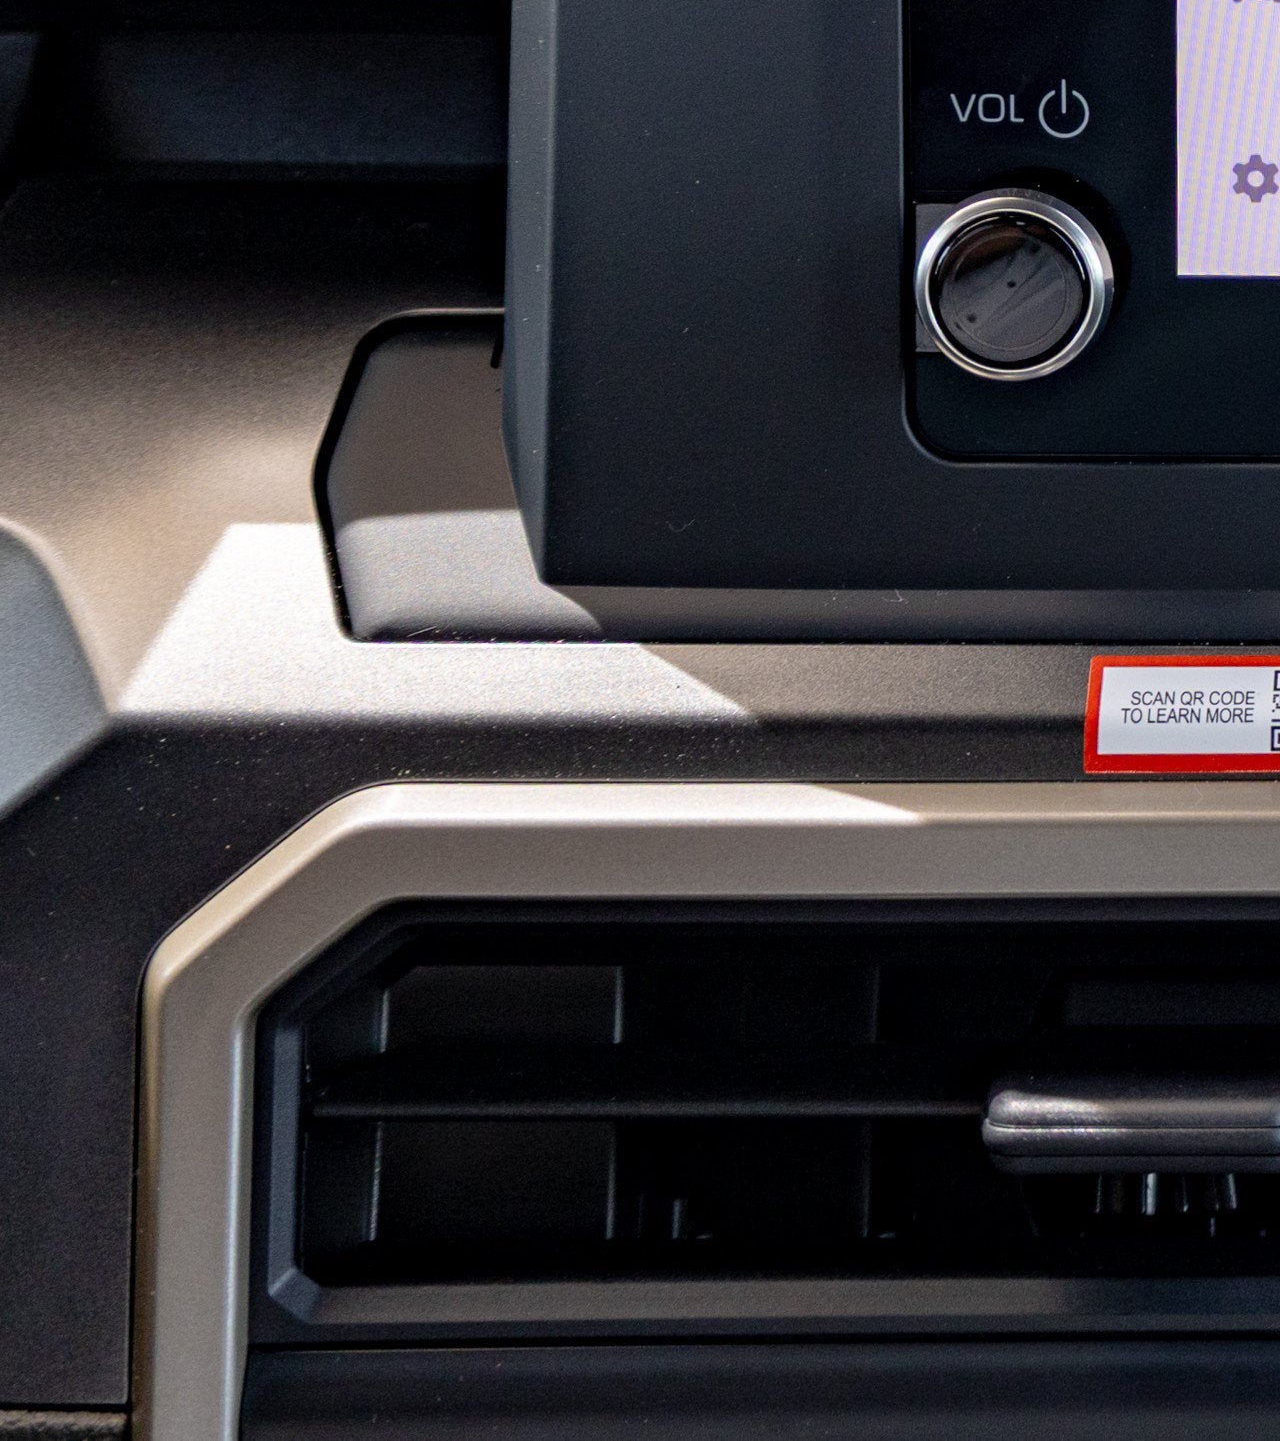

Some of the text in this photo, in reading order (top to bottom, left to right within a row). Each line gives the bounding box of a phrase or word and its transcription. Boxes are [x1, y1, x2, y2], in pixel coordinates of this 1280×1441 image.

[950, 93, 1024, 123] VOL
[1131, 691, 1255, 706] SCAN QR CODE
[1121, 708, 1254, 723] TO LEARN MORE
